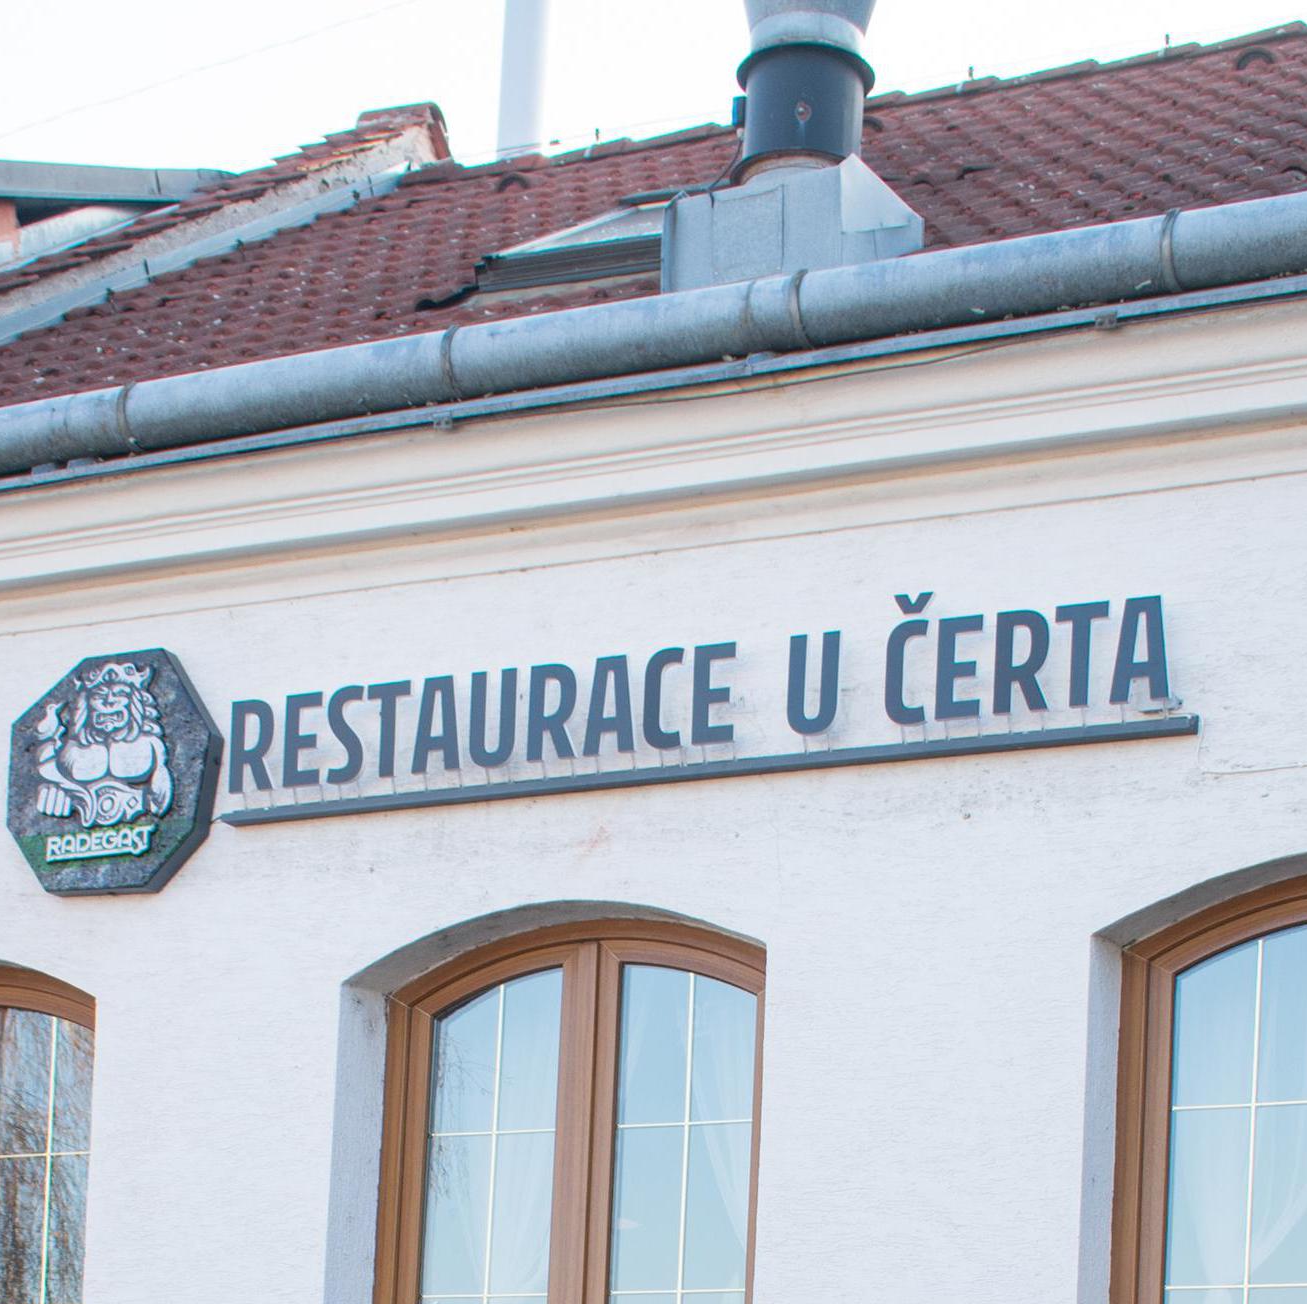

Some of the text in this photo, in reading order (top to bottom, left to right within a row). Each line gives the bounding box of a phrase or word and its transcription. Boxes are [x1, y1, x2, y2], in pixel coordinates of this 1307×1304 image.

[228, 591, 1171, 795] RESTAURACE U ČERTA
[46, 823, 158, 863] RADEGAST
